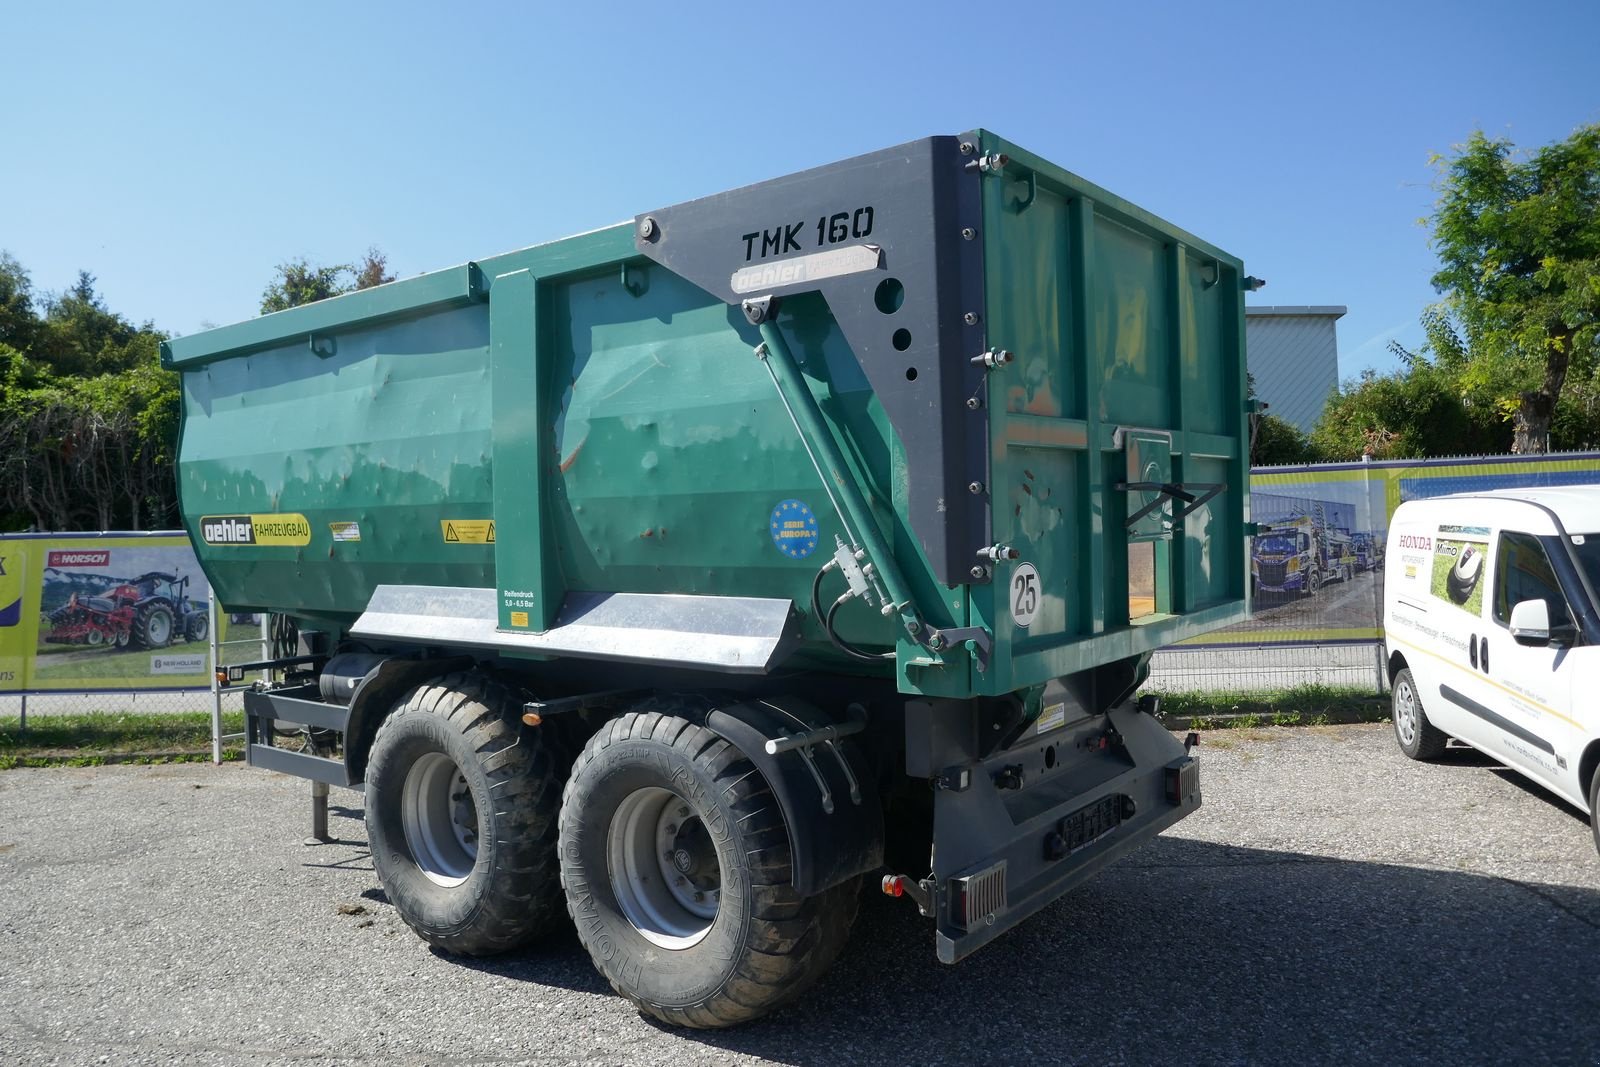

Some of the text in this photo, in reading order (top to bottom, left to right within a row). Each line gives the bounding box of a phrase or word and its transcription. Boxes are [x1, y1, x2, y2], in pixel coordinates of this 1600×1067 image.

[742, 206, 875, 261] TMK 160
[783, 520, 805, 529] SERIE
[204, 519, 252, 542] oehler
[255, 521, 308, 538] FAHRZEUGBAU
[780, 530, 811, 538] EUROPA
[1399, 535, 1432, 551] HONDA
[61, 554, 107, 564] HORSCH
[504, 590, 534, 598] Reifendruck
[1014, 573, 1036, 617] 25
[524, 600, 534, 608] Bar
